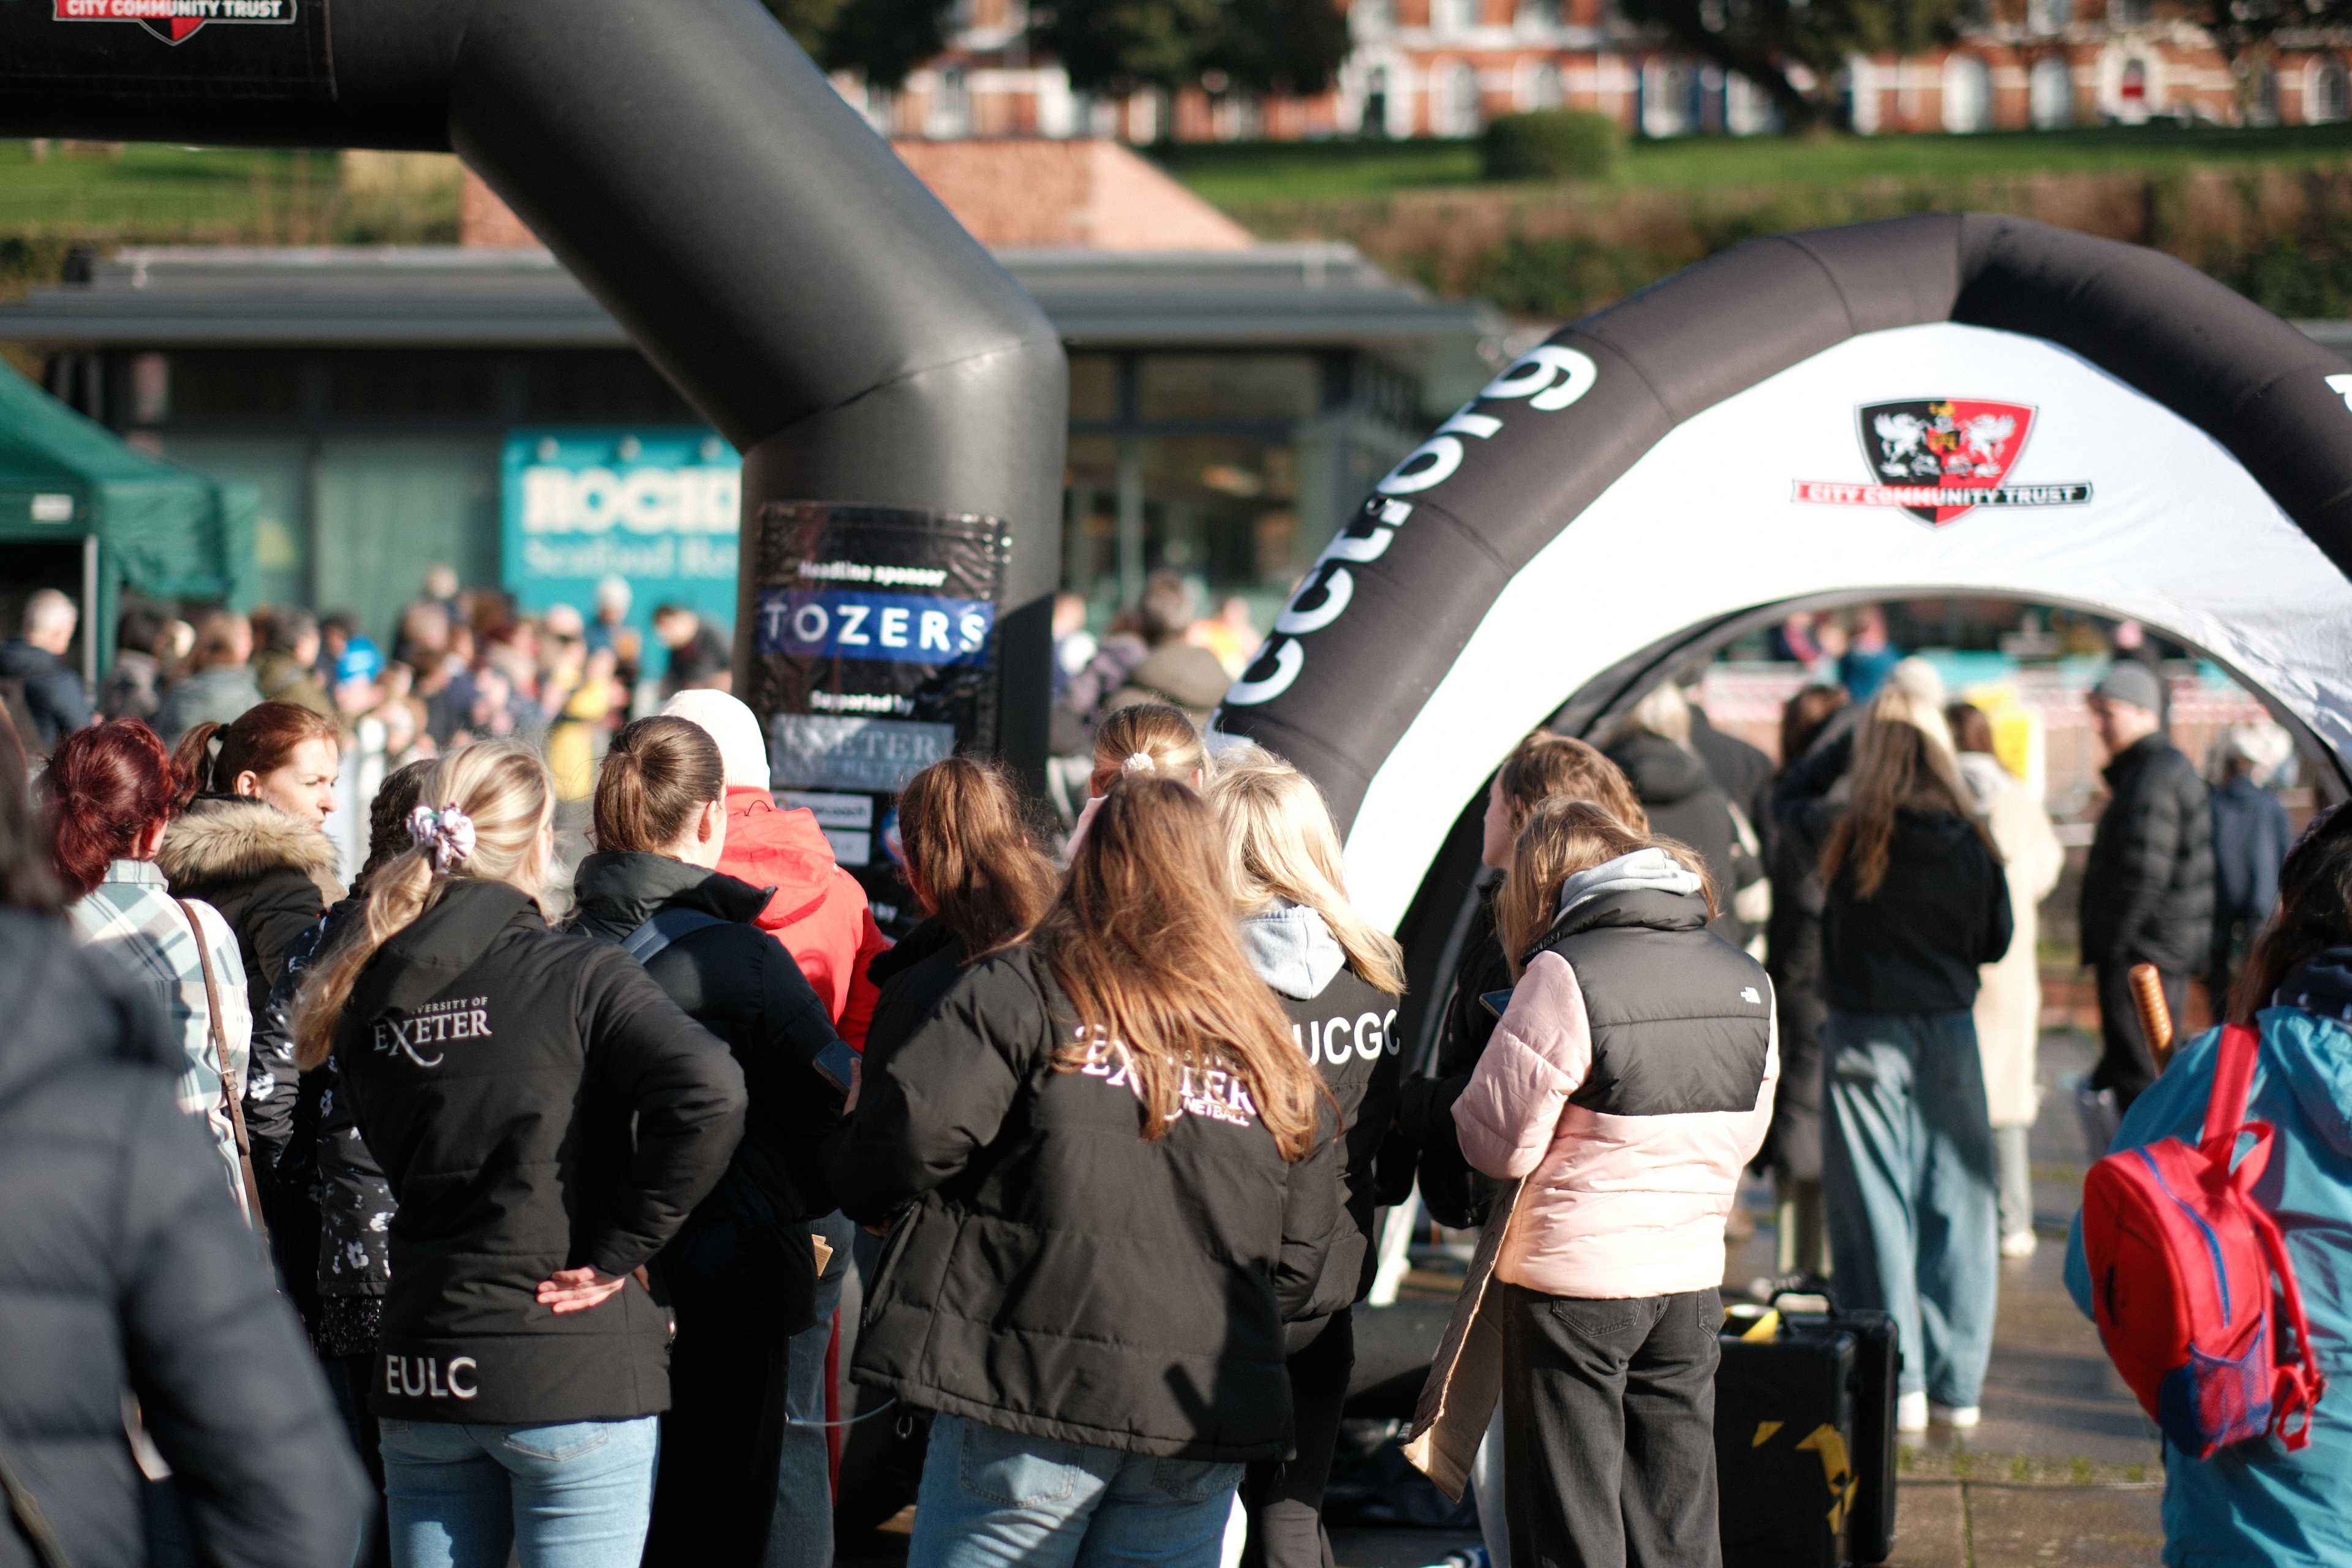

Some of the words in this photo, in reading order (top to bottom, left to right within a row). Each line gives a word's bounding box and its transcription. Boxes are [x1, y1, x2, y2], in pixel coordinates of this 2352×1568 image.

[67, 0, 108, 16] CITY
[111, 0, 221, 17] COMMUNITY
[221, 0, 283, 18] TRUST
[1807, 483, 1858, 503] CITY
[1863, 485, 2003, 506] COMMUNITY
[2005, 486, 2077, 505] TRUST
[799, 560, 872, 582] Headline
[873, 565, 948, 587] sponsor
[764, 602, 986, 654] TOZERS
[809, 690, 892, 713] Supported
[411, 999, 467, 1015] VERSITY
[472, 997, 489, 1007] OF
[370, 1009, 492, 1067] EXETER
[386, 1354, 478, 1398] EULC
